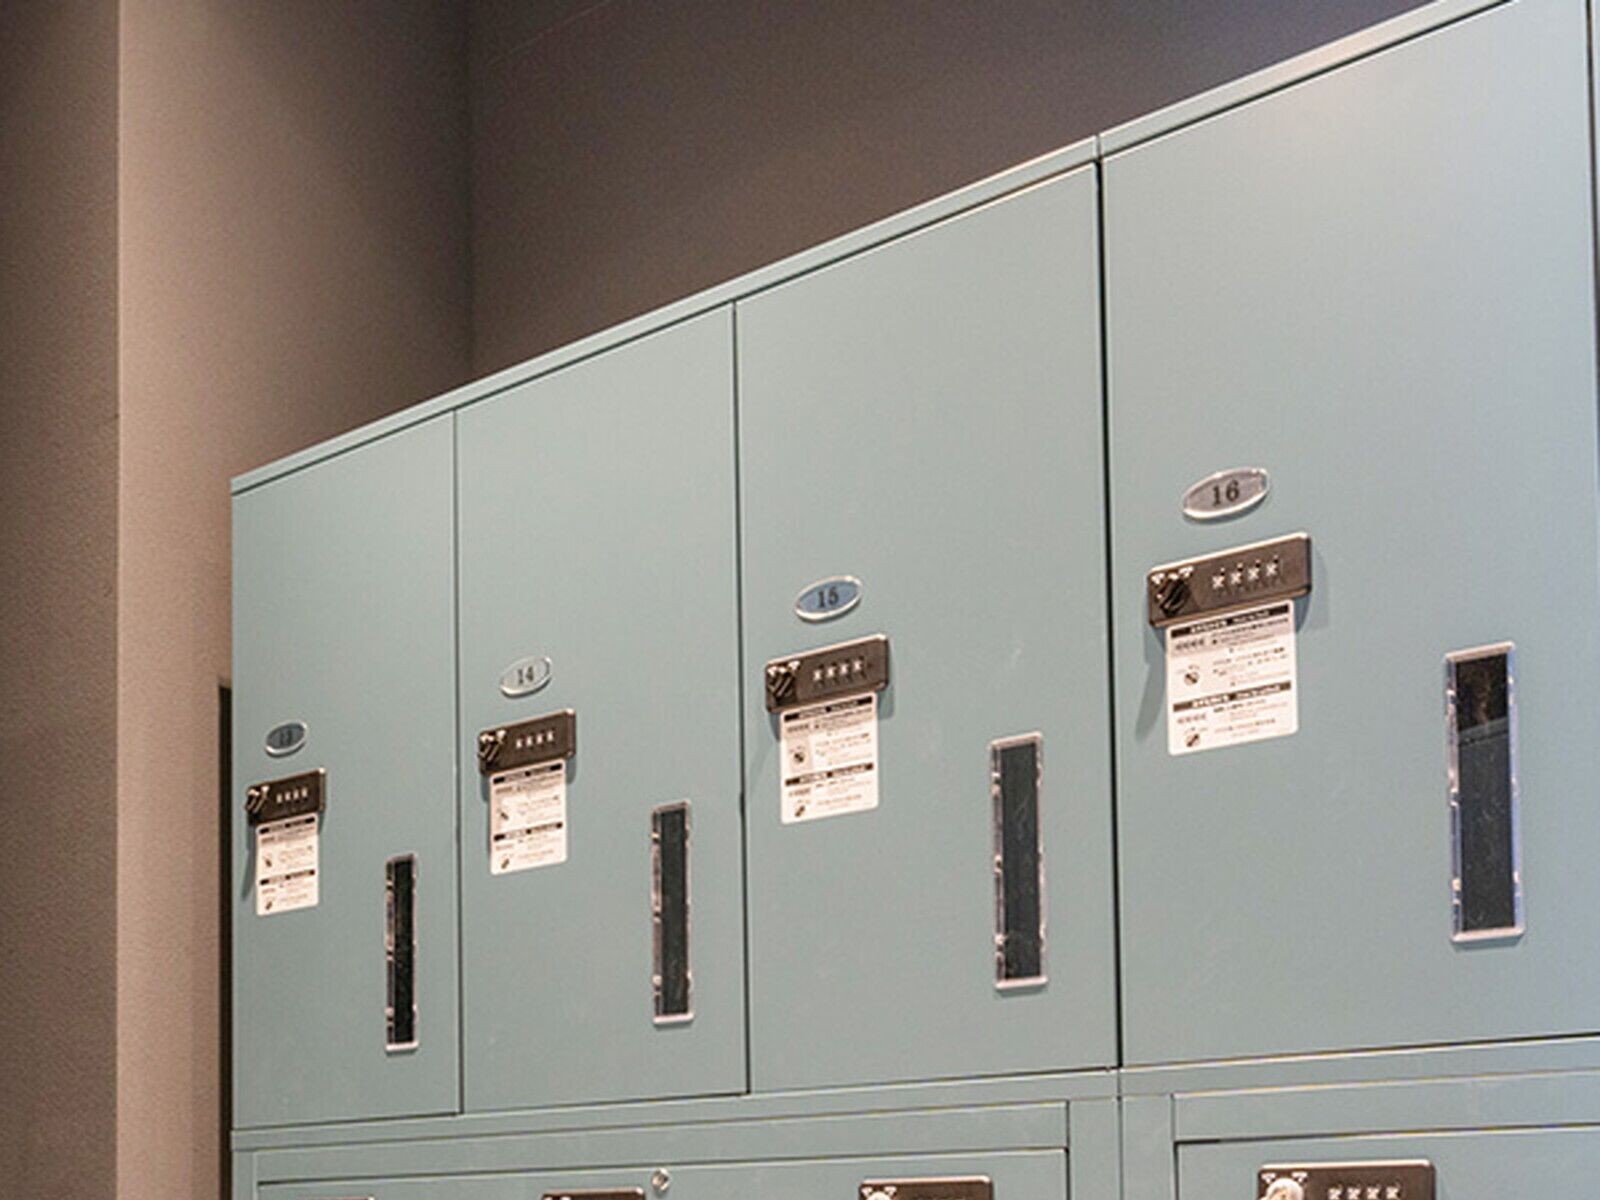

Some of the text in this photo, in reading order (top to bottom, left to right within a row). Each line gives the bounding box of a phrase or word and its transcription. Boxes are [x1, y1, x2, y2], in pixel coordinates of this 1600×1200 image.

[1211, 480, 1240, 505] 16
[817, 586, 839, 609] 15
[517, 666, 534, 686] 14
